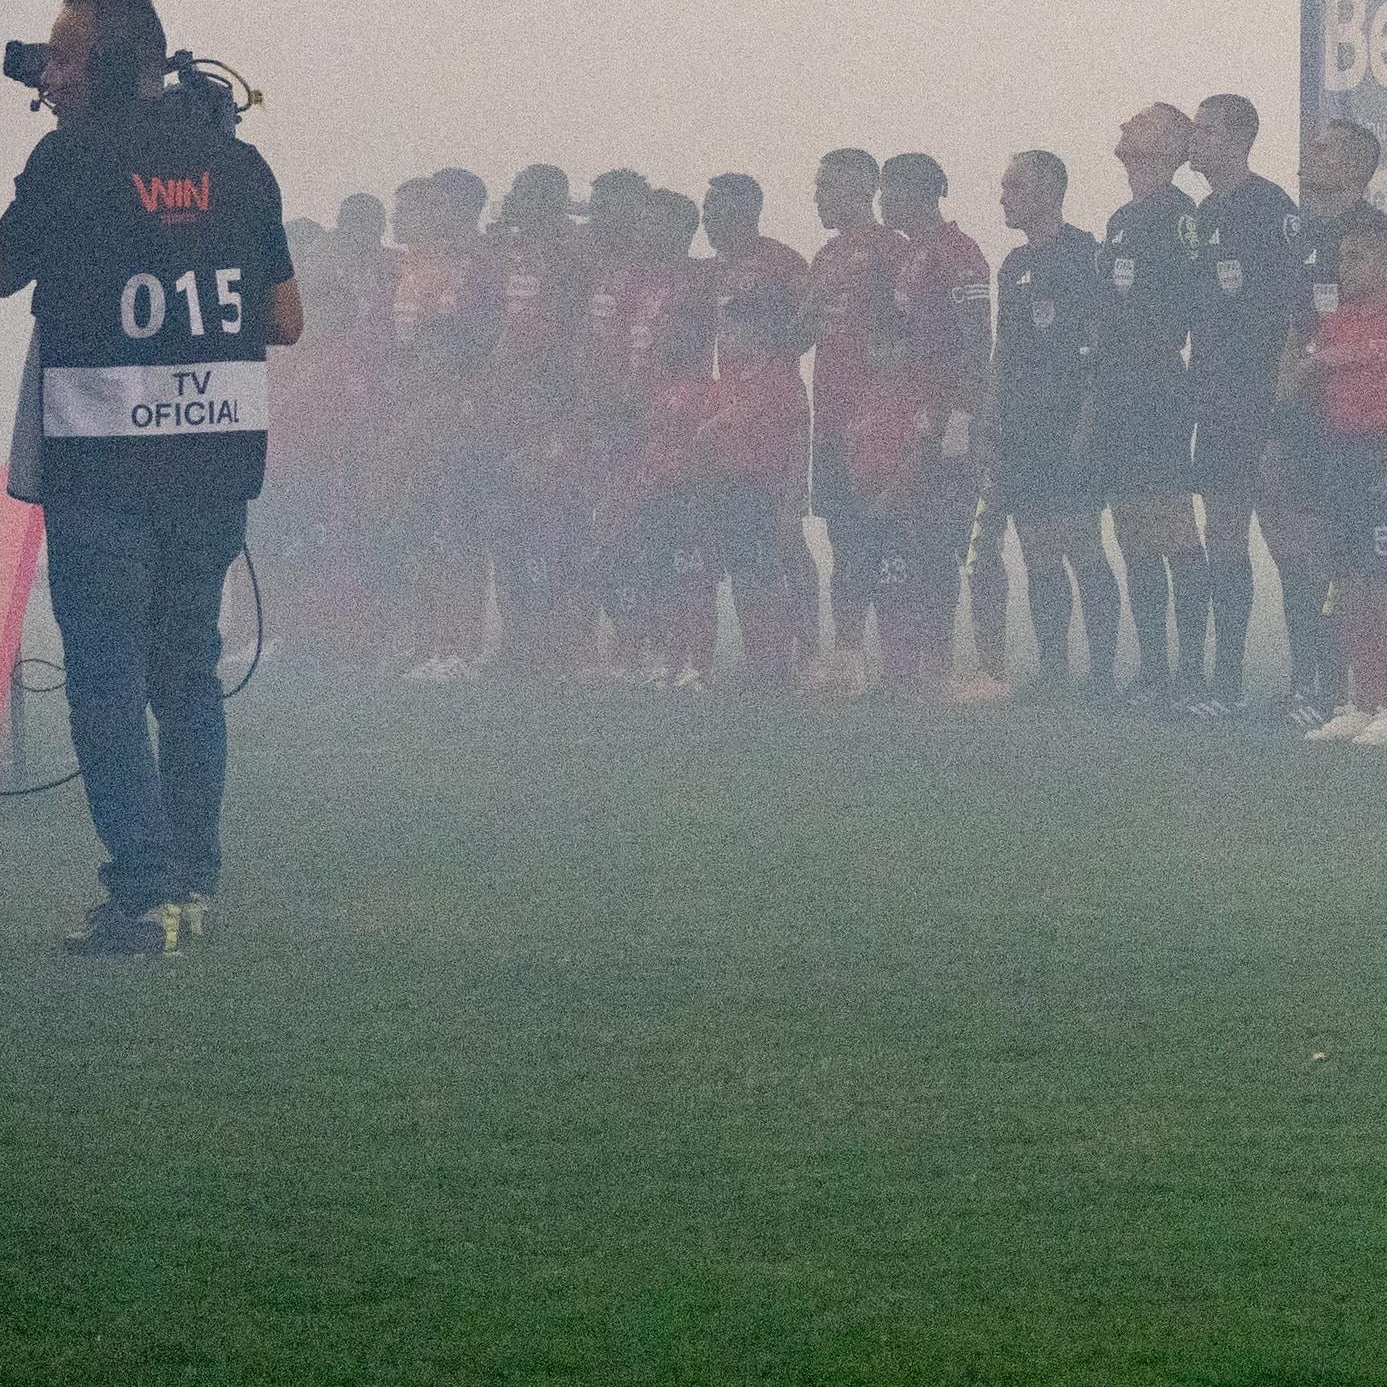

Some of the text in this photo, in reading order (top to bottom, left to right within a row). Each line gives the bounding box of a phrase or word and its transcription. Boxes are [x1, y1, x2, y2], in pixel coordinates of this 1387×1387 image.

[131, 170, 210, 213] WIN
[120, 268, 242, 338] 015
[173, 371, 211, 396] TV
[131, 400, 239, 427] OFICIAL
